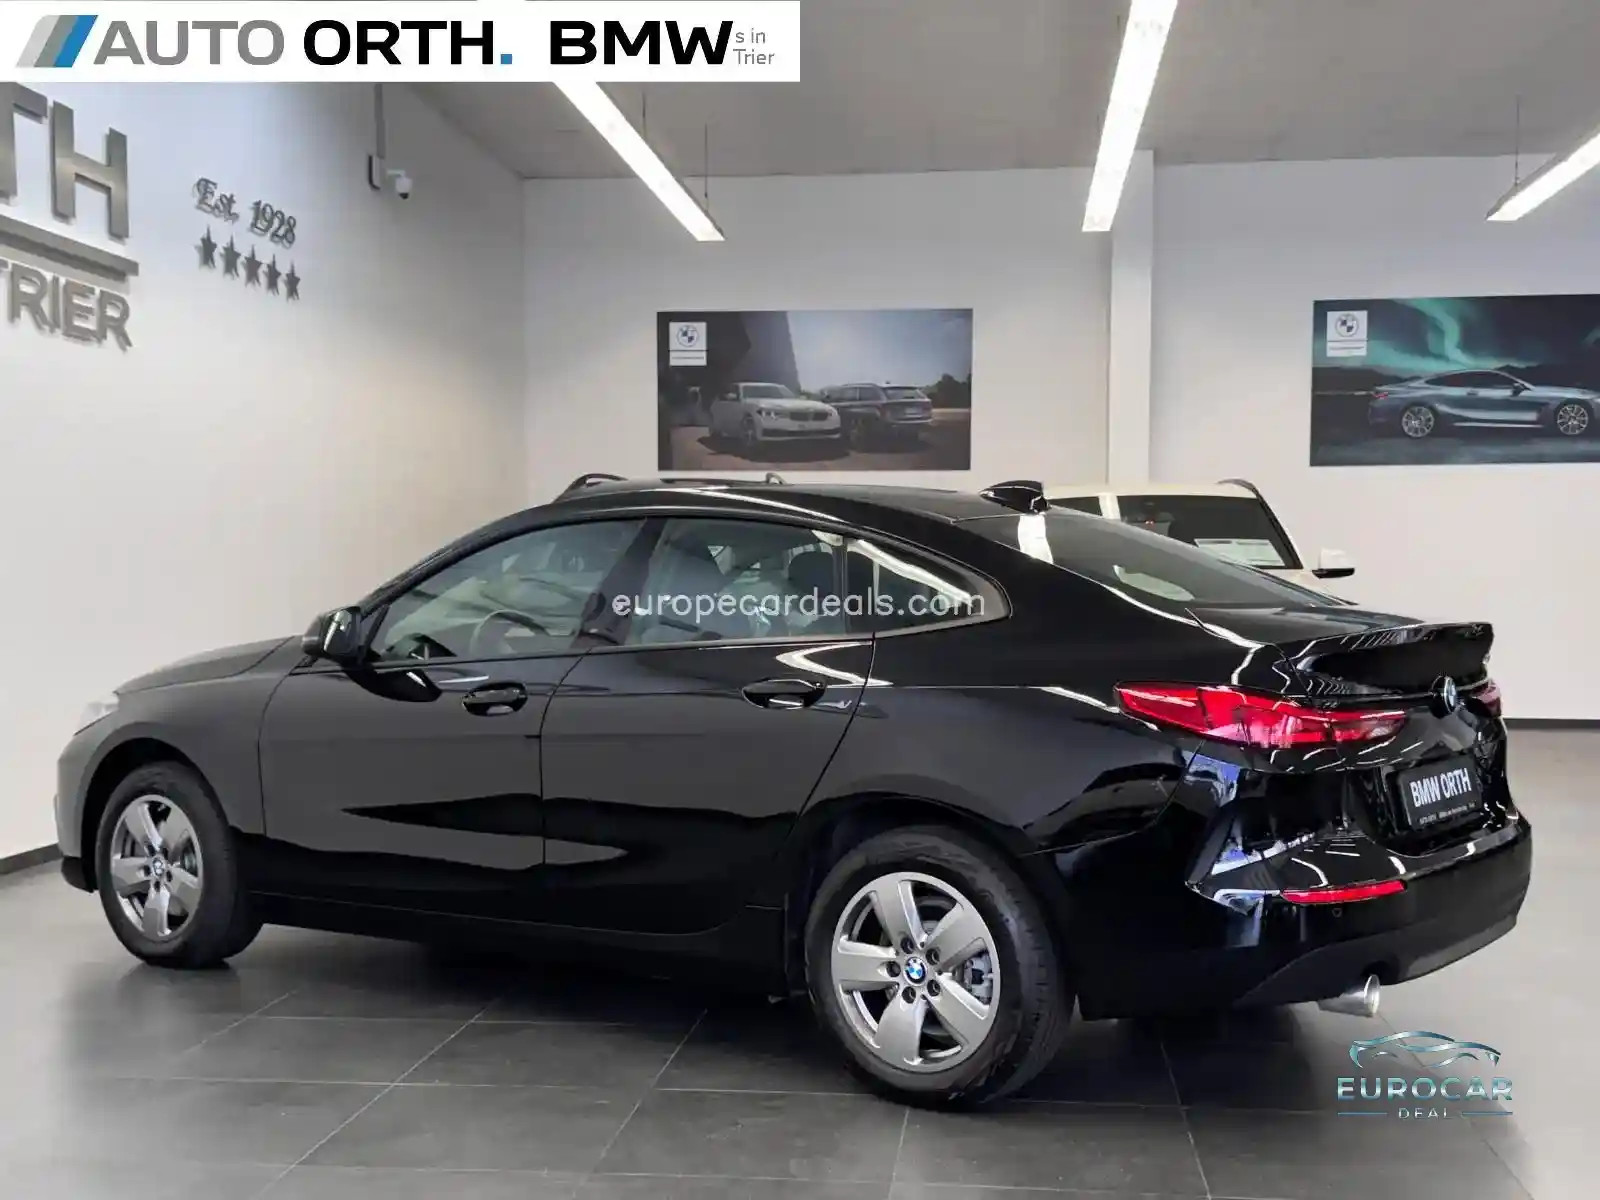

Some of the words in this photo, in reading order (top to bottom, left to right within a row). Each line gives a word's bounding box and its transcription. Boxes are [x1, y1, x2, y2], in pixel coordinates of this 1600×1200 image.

[250, 199, 297, 247] 1928
[0, 258, 132, 350] RIER
[1409, 775, 1441, 808] BMW
[1440, 767, 1472, 799] ORTH
